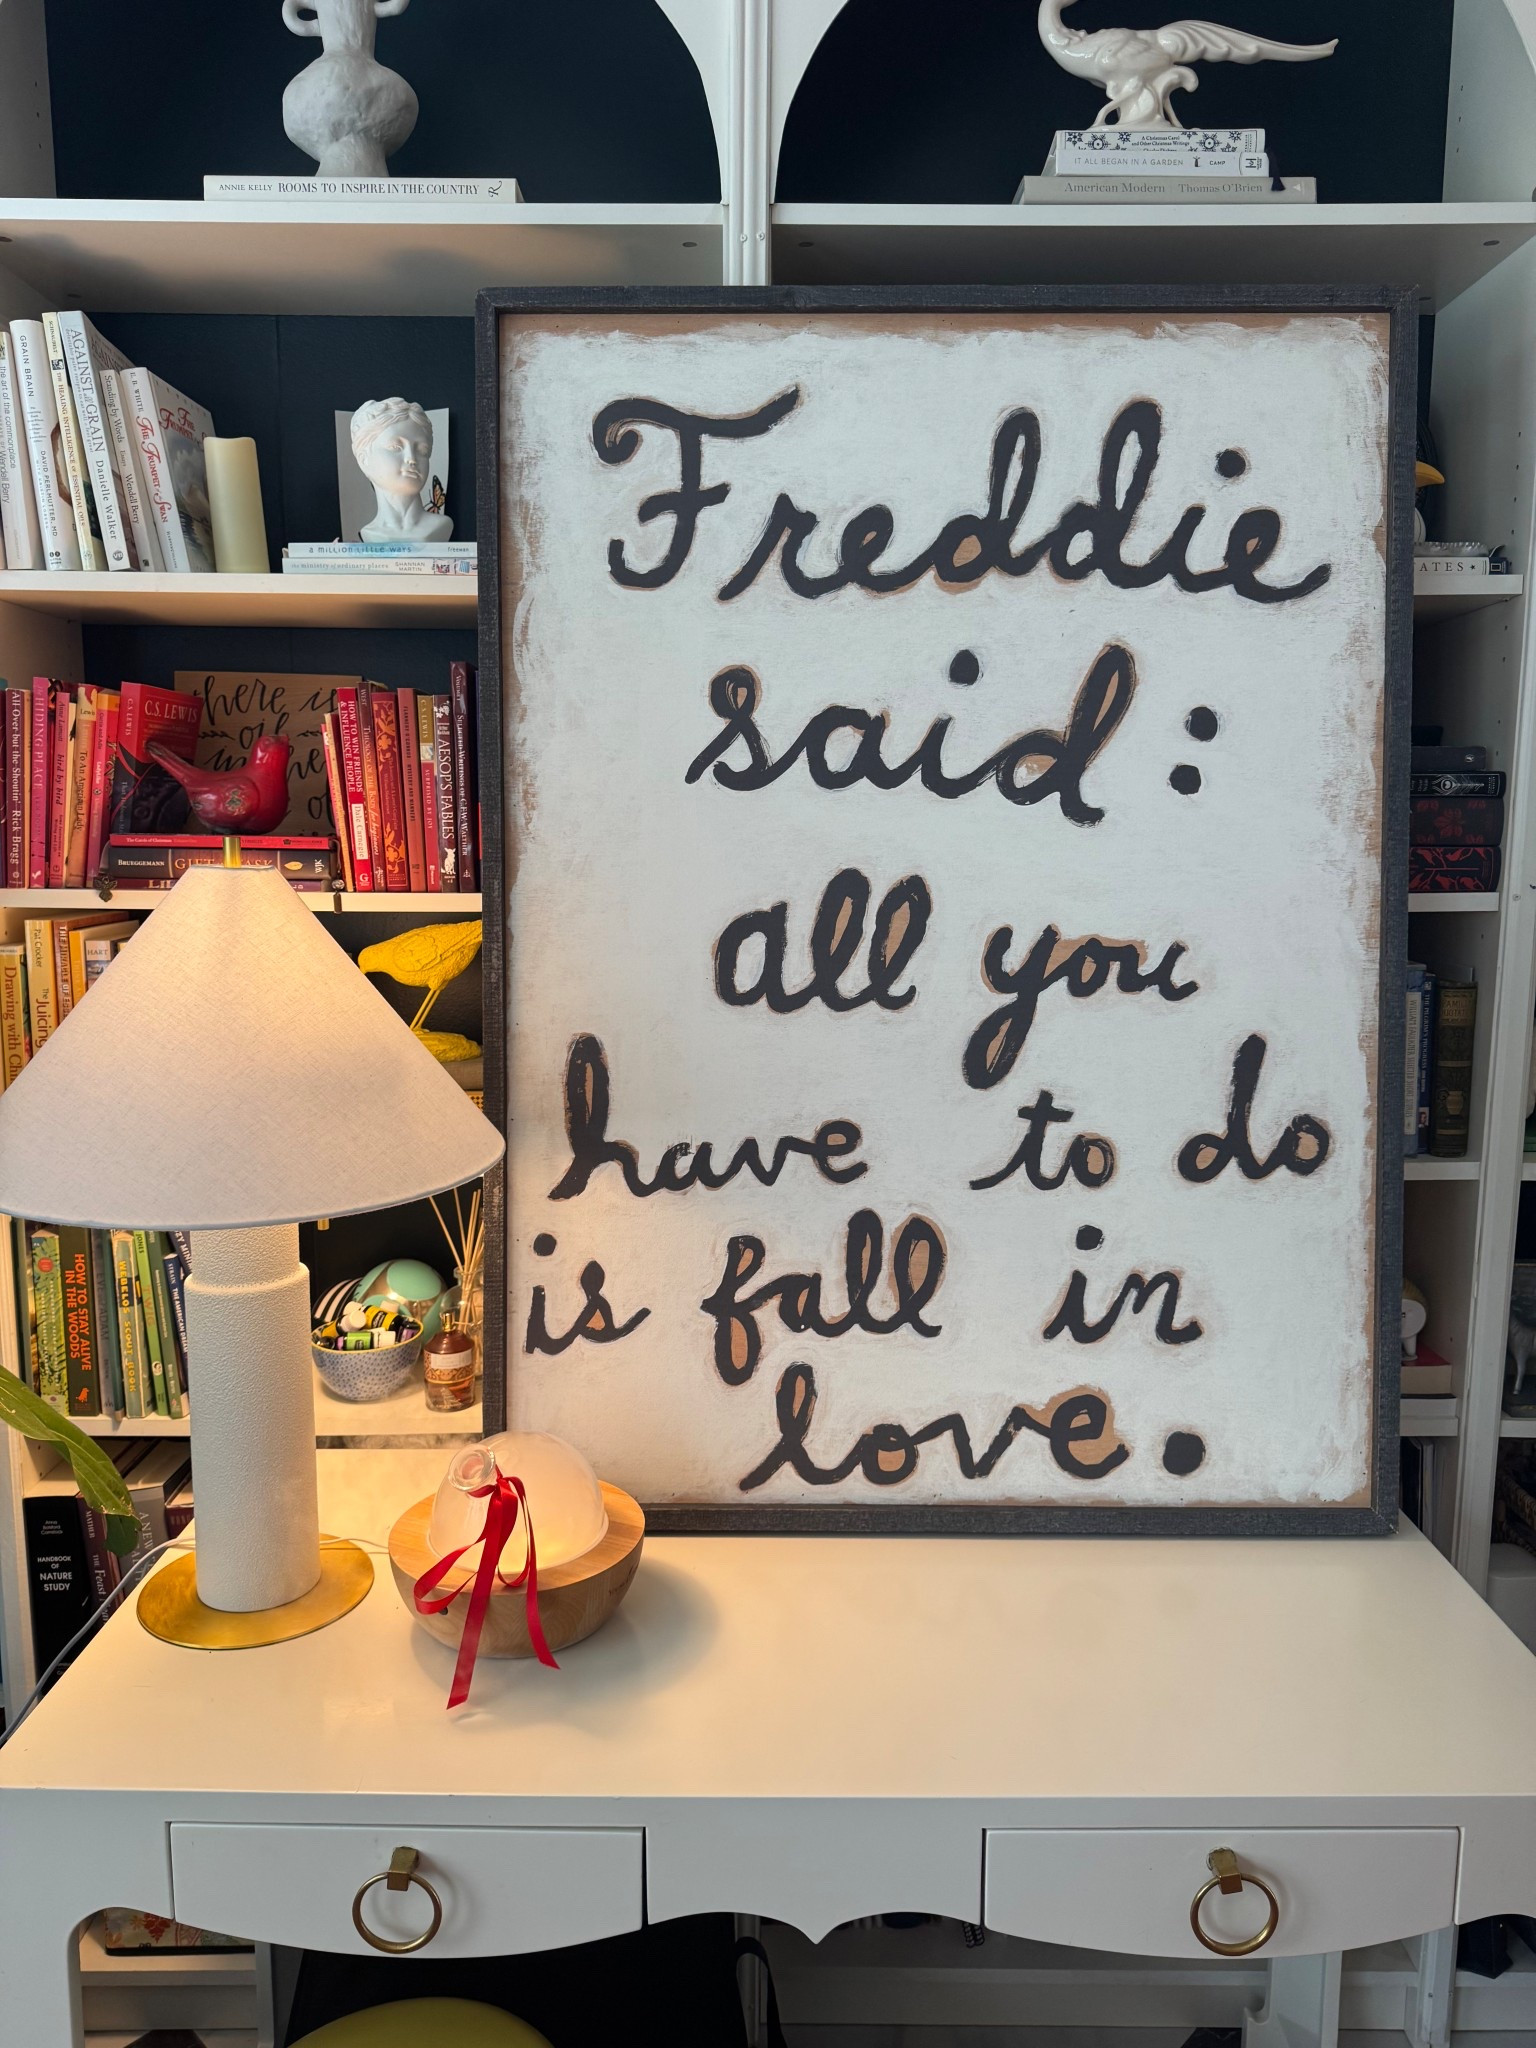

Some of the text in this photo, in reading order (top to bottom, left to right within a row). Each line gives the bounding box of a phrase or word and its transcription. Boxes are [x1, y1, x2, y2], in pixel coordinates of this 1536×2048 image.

[278, 182, 318, 193] ROOMS
[321, 183, 337, 193] TO
[341, 183, 384, 193] INSPIRE
[388, 184, 399, 194] IN
[402, 184, 424, 194] THE
[427, 184, 480, 194] COUNTRY
[1064, 183, 1262, 192] American Modern Thomas O'Brien
[2, 380, 10, 390] art
[3, 392, 10, 400] of
[105, 376, 116, 407] Standing
[135, 390, 144, 412] WHITE
[111, 408, 119, 417] by
[4, 416, 17, 469] commonplace
[20, 335, 58, 536] GRAIN BRAIN DAVID MD
[58, 384, 82, 508] HEALING INTELLIGENCE ESSENTIAL
[71, 329, 116, 540] AGAINST GRAIN Danielle Walker
[114, 418, 125, 444] Words
[2, 483, 10, 503] Berry
[125, 474, 137, 504] Wendell
[593, 386, 1331, 603] Freddie
[301, 562, 330, 570] ministry
[34, 697, 44, 747] HIDING
[144, 700, 162, 716] C.S.
[164, 703, 198, 722] LEWIS
[340, 711, 351, 757] INFLUENCE
[346, 761, 355, 792] PEOPLE
[348, 701, 362, 792] HOW TO WIN FRIENDS
[363, 726, 372, 762] THEOLOGY
[10, 692, 22, 865] All Over but the Shoutin' Rick Bragg
[34, 751, 44, 786] PLACE
[56, 774, 63, 785] by
[438, 739, 453, 790] AESOP'S
[76, 752, 87, 832] To An American Lady
[369, 791, 377, 809] BODY
[458, 750, 469, 856] WRITINGS WALTHER
[426, 808, 432, 816] BY
[440, 795, 454, 839] FABLES
[354, 806, 365, 858] Dale Carnegie
[369, 823, 380, 855] beginners
[315, 859, 324, 874] WJK
[59, 926, 67, 943] THE
[34, 942, 42, 968] Crocker
[4, 966, 16, 1020] Drawing
[62, 984, 69, 994] OF
[715, 868, 1198, 1089] all you
[9, 1024, 20, 1050] with
[35, 998, 51, 1048] Juicing
[1407, 1000, 1417, 1055] WILLIAM FAULKNER
[548, 1034, 1331, 1200] have to do
[97, 1273, 106, 1292] EVE
[136, 1234, 155, 1326] JONES TWIG
[168, 1263, 176, 1284] STRAIN
[174, 1300, 184, 1331] AMERICAN
[65, 1270, 80, 1358] IN THE WOODS
[75, 1254, 91, 1370] HOW TO STAY ALIVE
[526, 1209, 1202, 1389] is fall in
[100, 1310, 108, 1340] ADAM
[119, 1260, 136, 1392] WEBELOS SCOUT BOOK
[139, 1512, 149, 1524] A
[142, 1522, 155, 1548] NEW
[85, 1511, 96, 1538] MATHER
[95, 1569, 106, 1595] Feast
[40, 1572, 72, 1580] NATURE
[44, 1583, 70, 1592] STUDY
